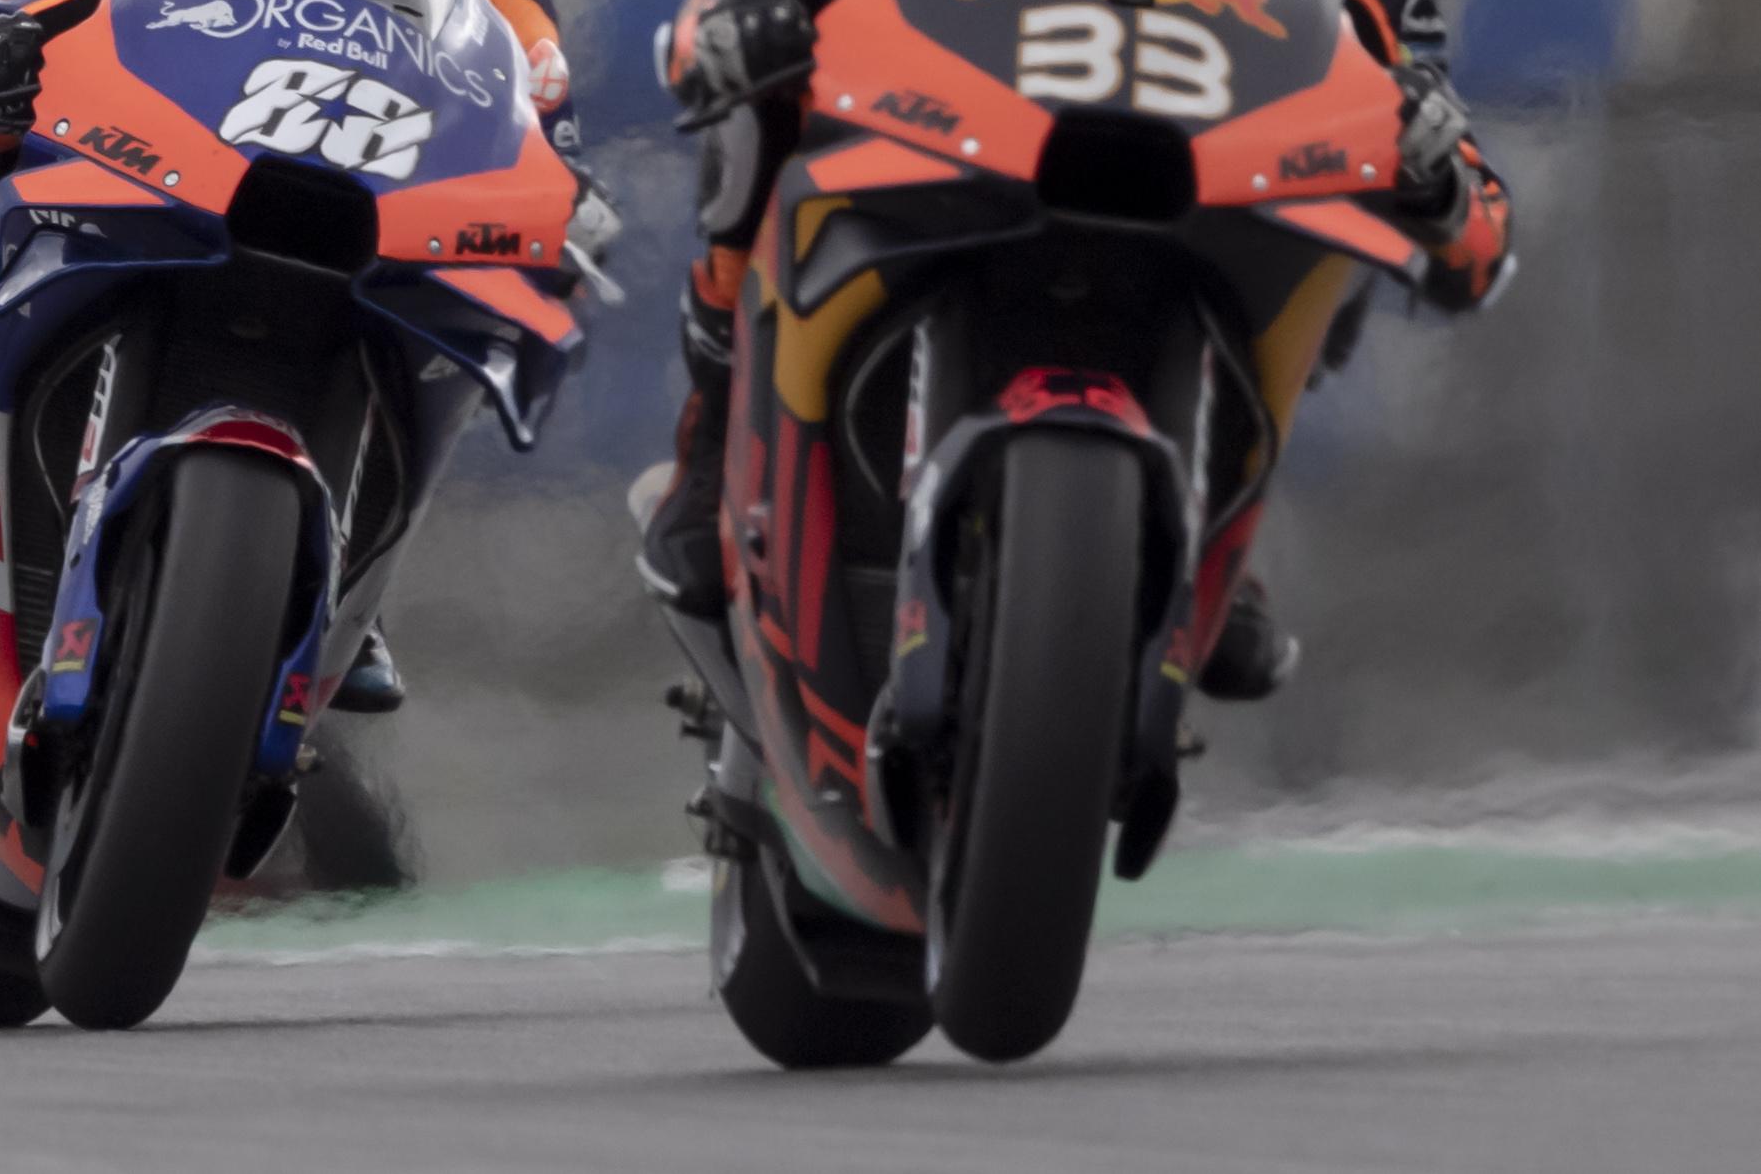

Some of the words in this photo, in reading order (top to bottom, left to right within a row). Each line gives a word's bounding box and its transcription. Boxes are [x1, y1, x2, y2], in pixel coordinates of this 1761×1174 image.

[298, 32, 342, 54] Red
[346, 36, 388, 70] Bull
[1015, 2, 1233, 119] 33
[218, 59, 433, 180] 88
[870, 90, 964, 134] KTM
[79, 126, 163, 176] KTM
[1277, 140, 1348, 181] KTM
[455, 222, 521, 256] KTM
